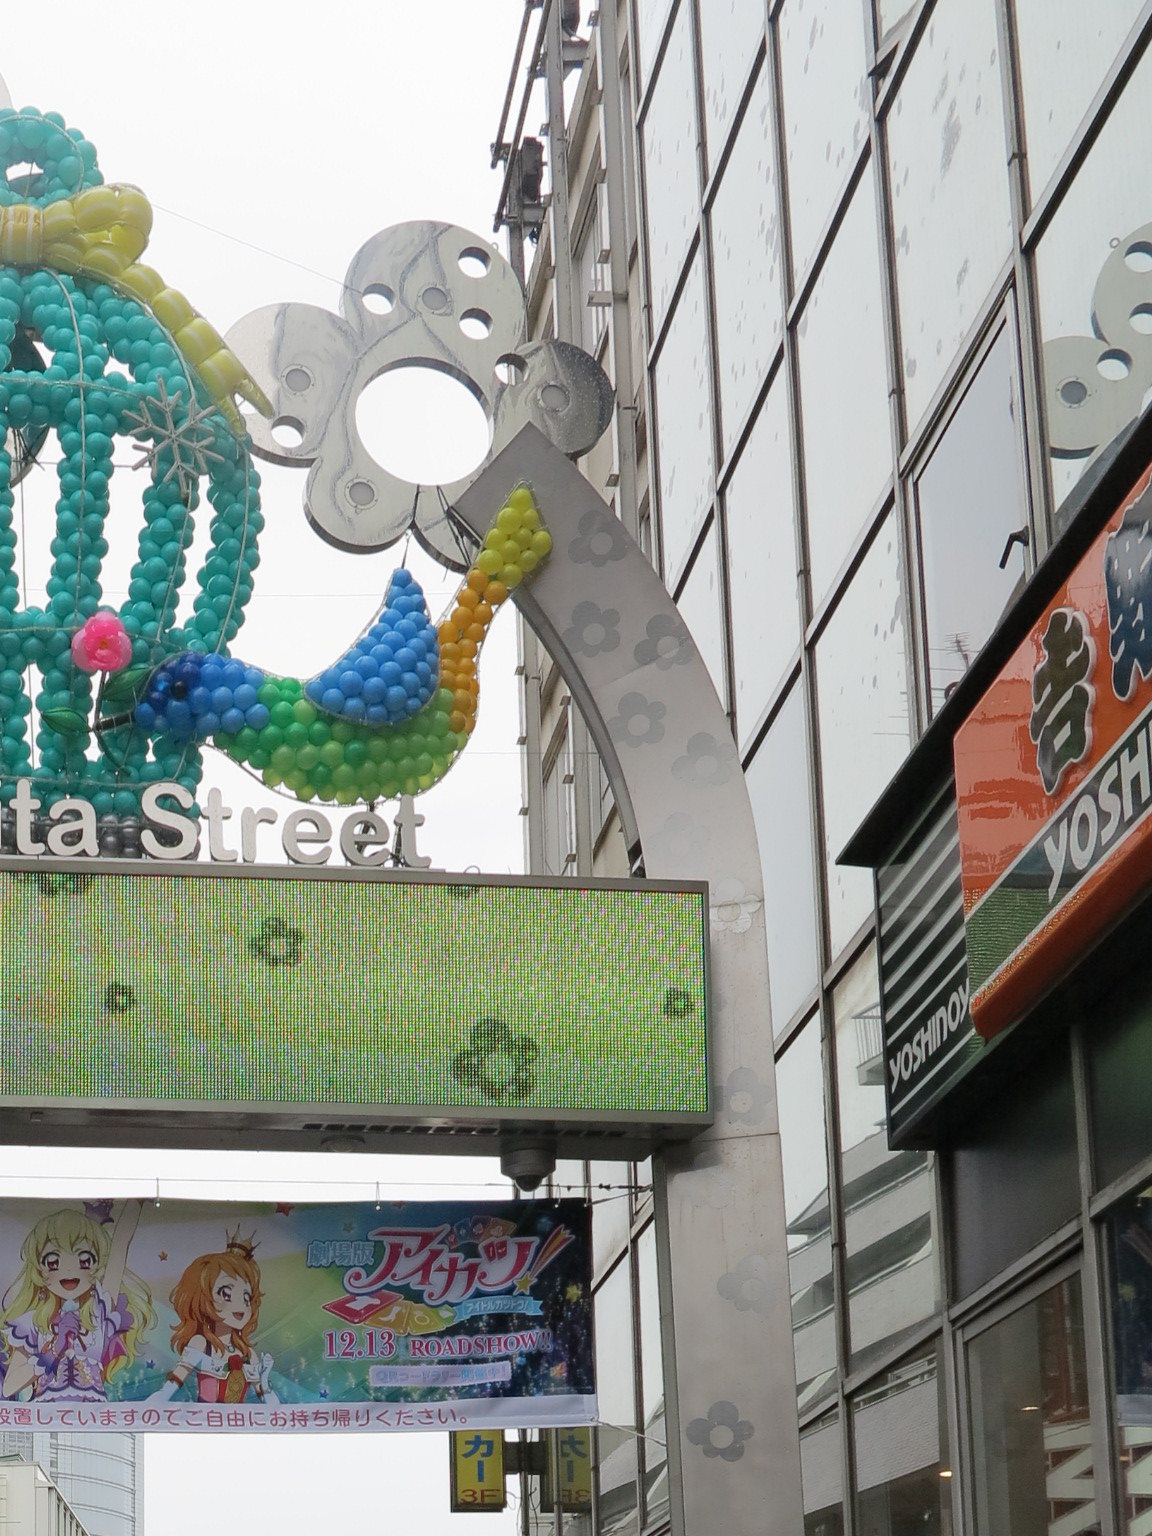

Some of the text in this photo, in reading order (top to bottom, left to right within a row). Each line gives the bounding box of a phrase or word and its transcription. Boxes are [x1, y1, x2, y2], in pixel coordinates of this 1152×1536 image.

[140, 782, 433, 870] Street
[1045, 720, 1152, 903] YOSH
[307, 1240, 375, 1268] 劇場版
[324, 1330, 553, 1359] 12.13 ROADSHOW!!
[461, 1489, 501, 1504] 3F
